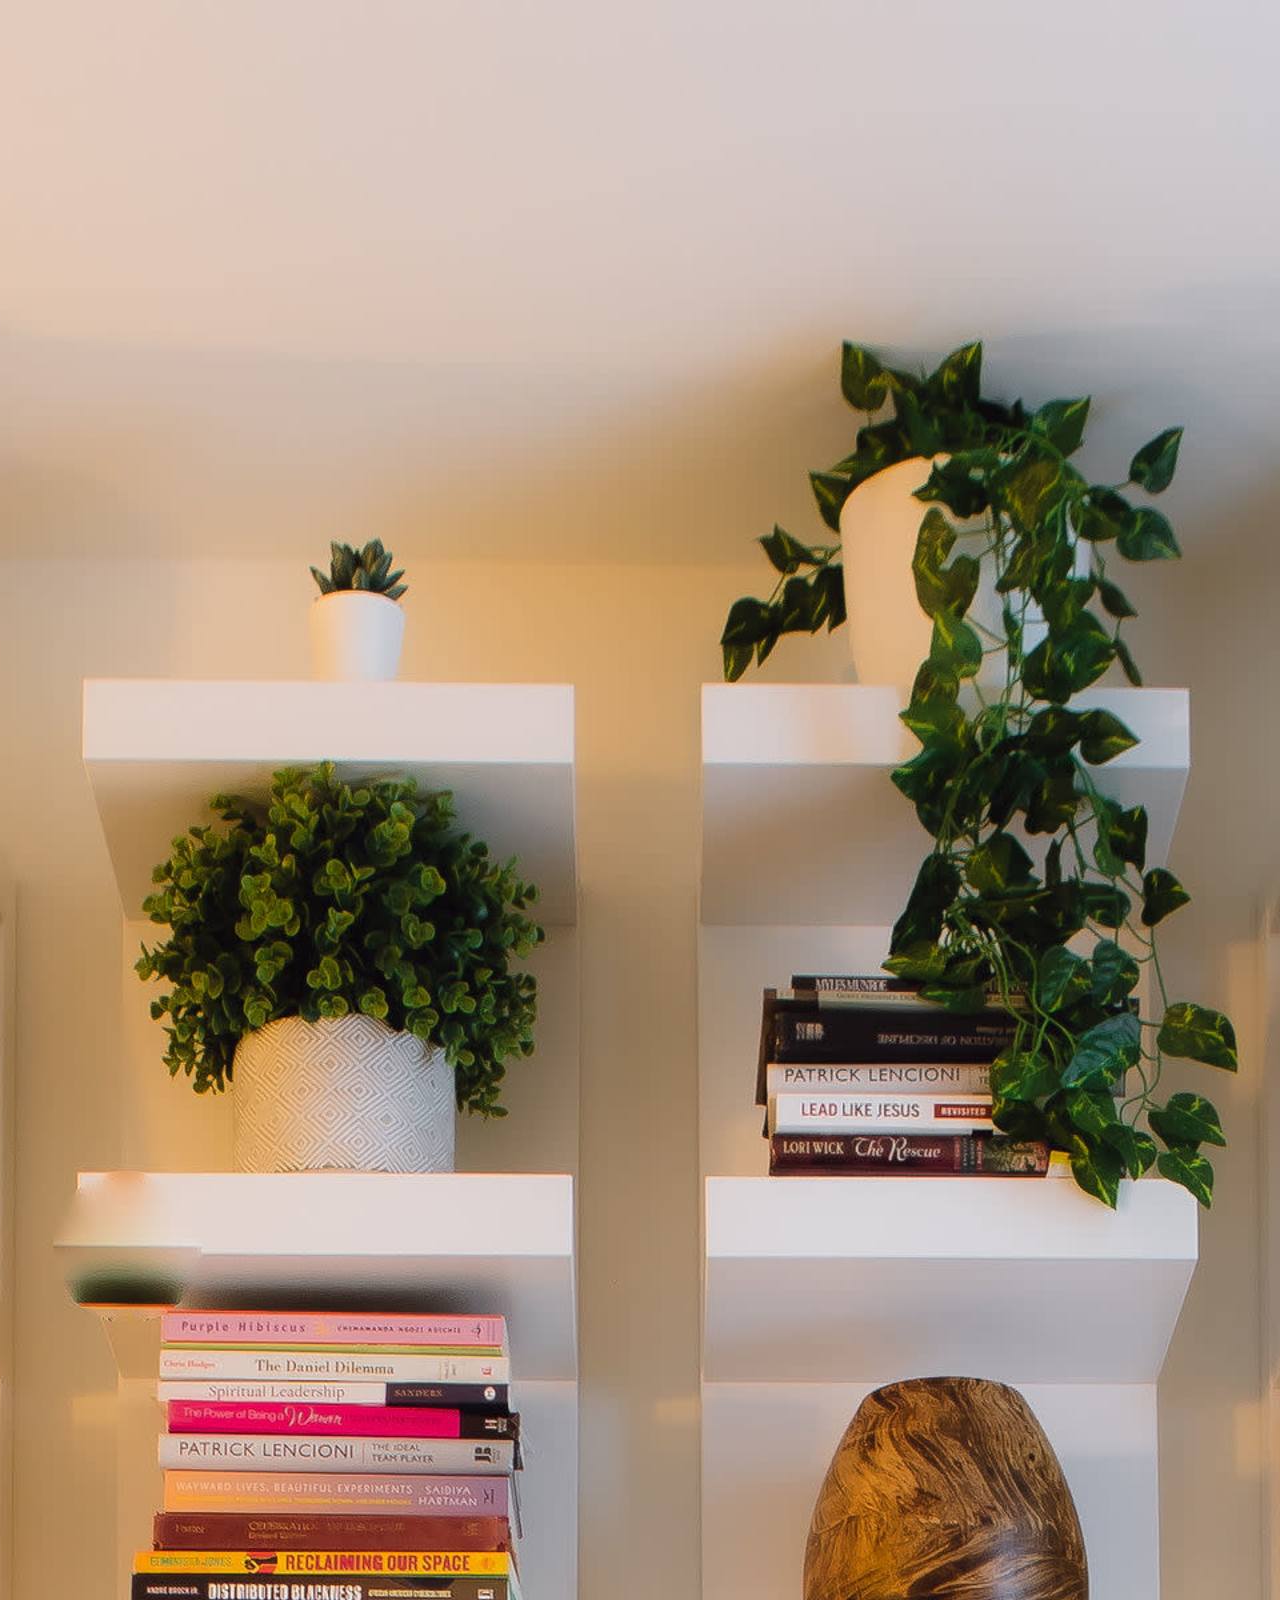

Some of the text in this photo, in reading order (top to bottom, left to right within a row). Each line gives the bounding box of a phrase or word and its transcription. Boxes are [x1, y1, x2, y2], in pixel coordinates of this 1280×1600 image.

[784, 1068, 960, 1082] PATRICK LENCIONI
[802, 1103, 920, 1118] LEAD LIKE JESUS
[286, 1553, 470, 1571] RECLAIMING OUR SPACE
